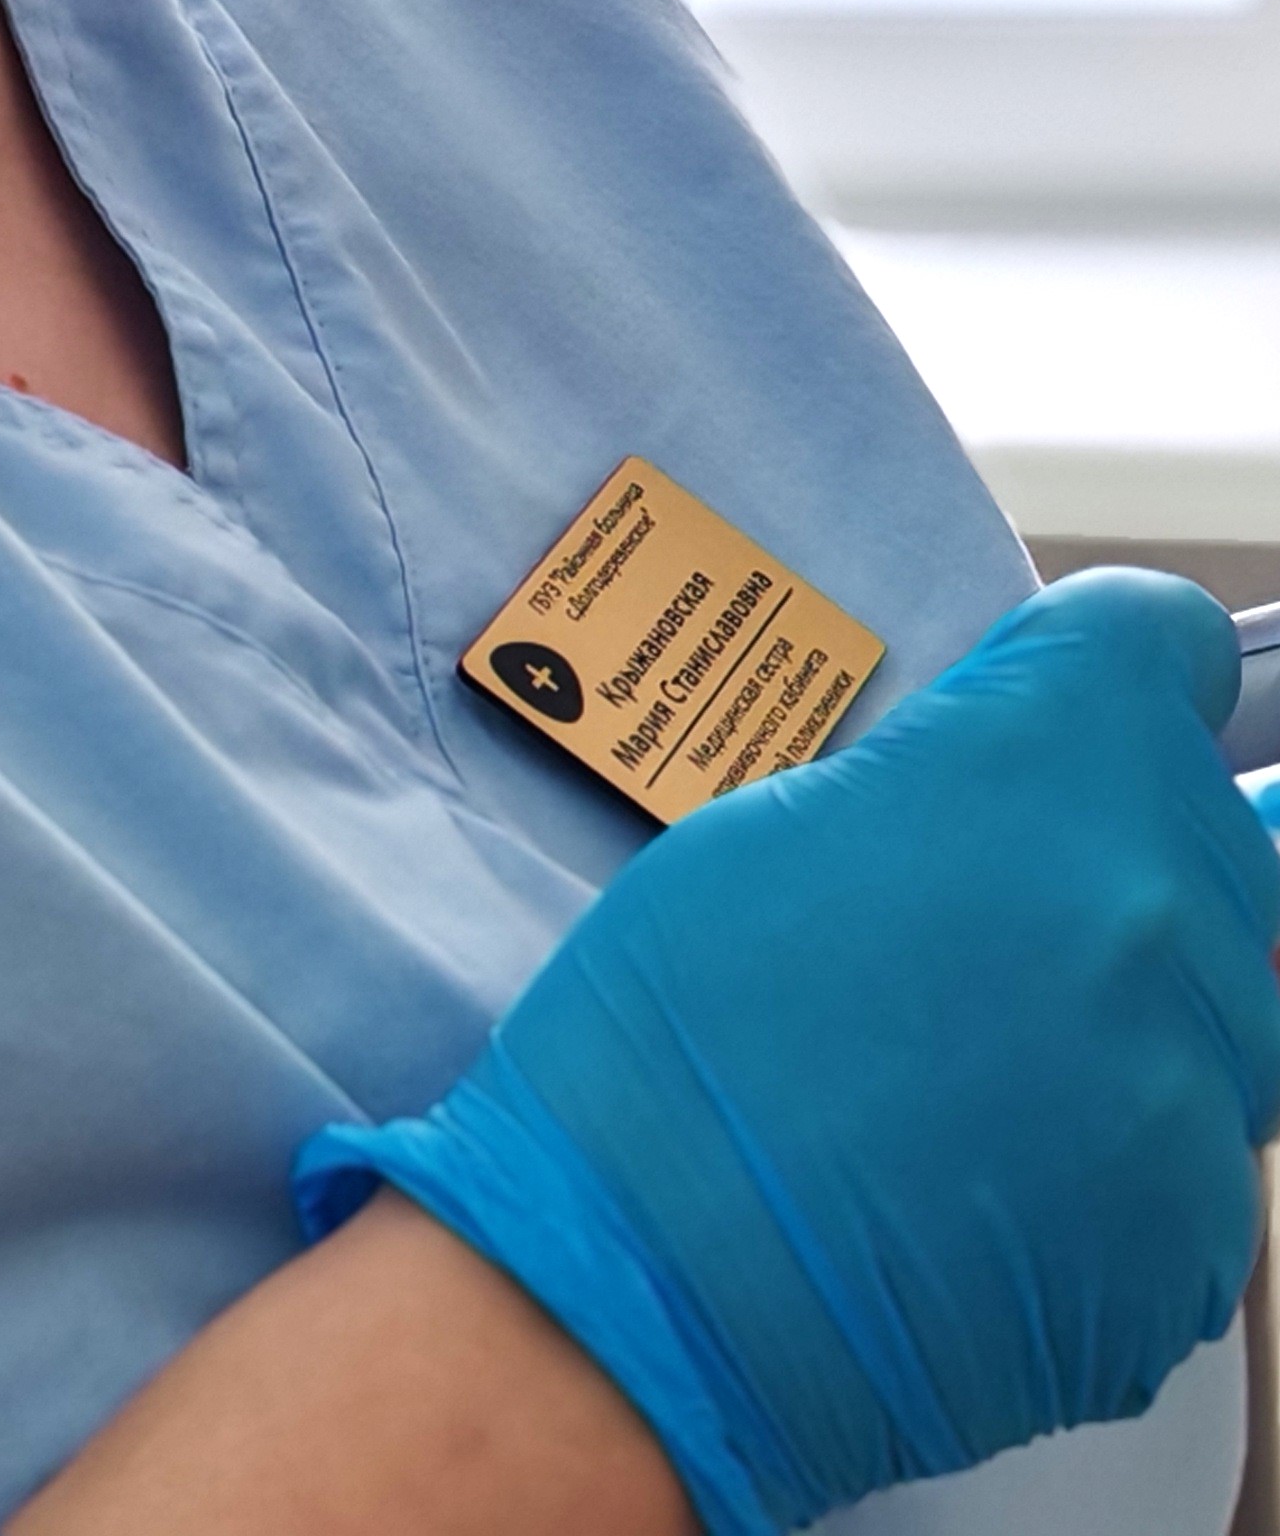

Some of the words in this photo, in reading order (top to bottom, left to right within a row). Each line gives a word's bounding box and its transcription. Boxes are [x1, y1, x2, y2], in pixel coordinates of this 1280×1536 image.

[528, 580, 562, 615] ГБУЗ
[595, 571, 715, 709] Крыжановская
[610, 700, 676, 772] Мария
[659, 570, 773, 703] Станиславовна
[686, 677, 764, 772] Медицинская
[756, 637, 795, 683] сестра
[779, 648, 829, 711] кабинета
[786, 669, 856, 759] поликлиники
